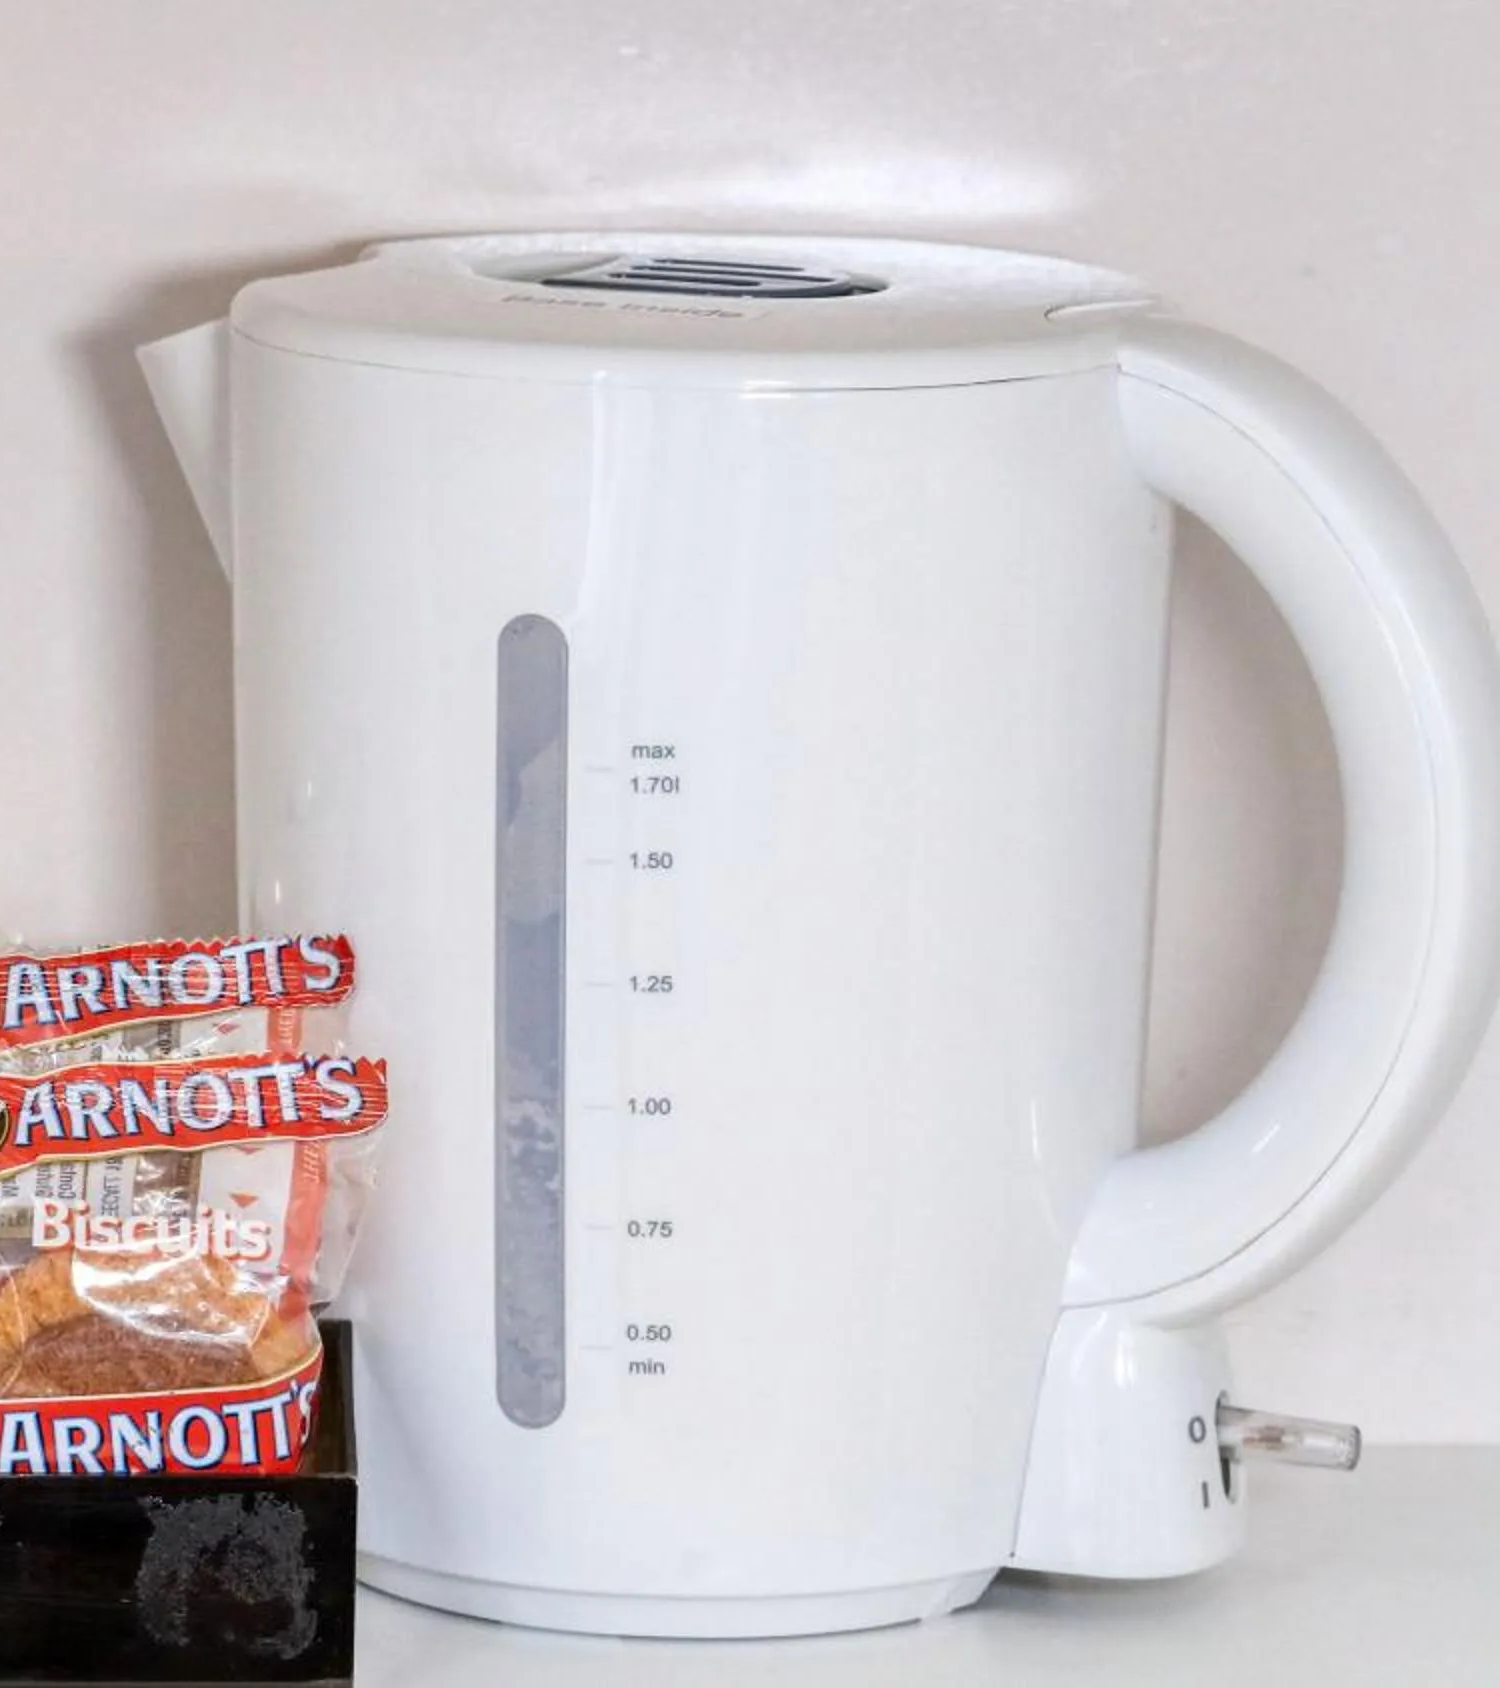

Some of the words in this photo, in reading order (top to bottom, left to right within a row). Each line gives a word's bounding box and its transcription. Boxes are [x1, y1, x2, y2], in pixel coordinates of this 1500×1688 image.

[631, 744, 677, 761] max
[629, 852, 674, 870] 1.50
[3, 934, 343, 1030] ARNOTT'S
[629, 976, 674, 994] 1.25
[14, 1054, 365, 1147] ARNOTT'S
[627, 1097, 672, 1115] 1.00
[31, 1197, 273, 1262] Biscuits
[627, 1221, 673, 1239] 0.75
[626, 1324, 672, 1342] 0.50
[629, 1359, 665, 1376] min
